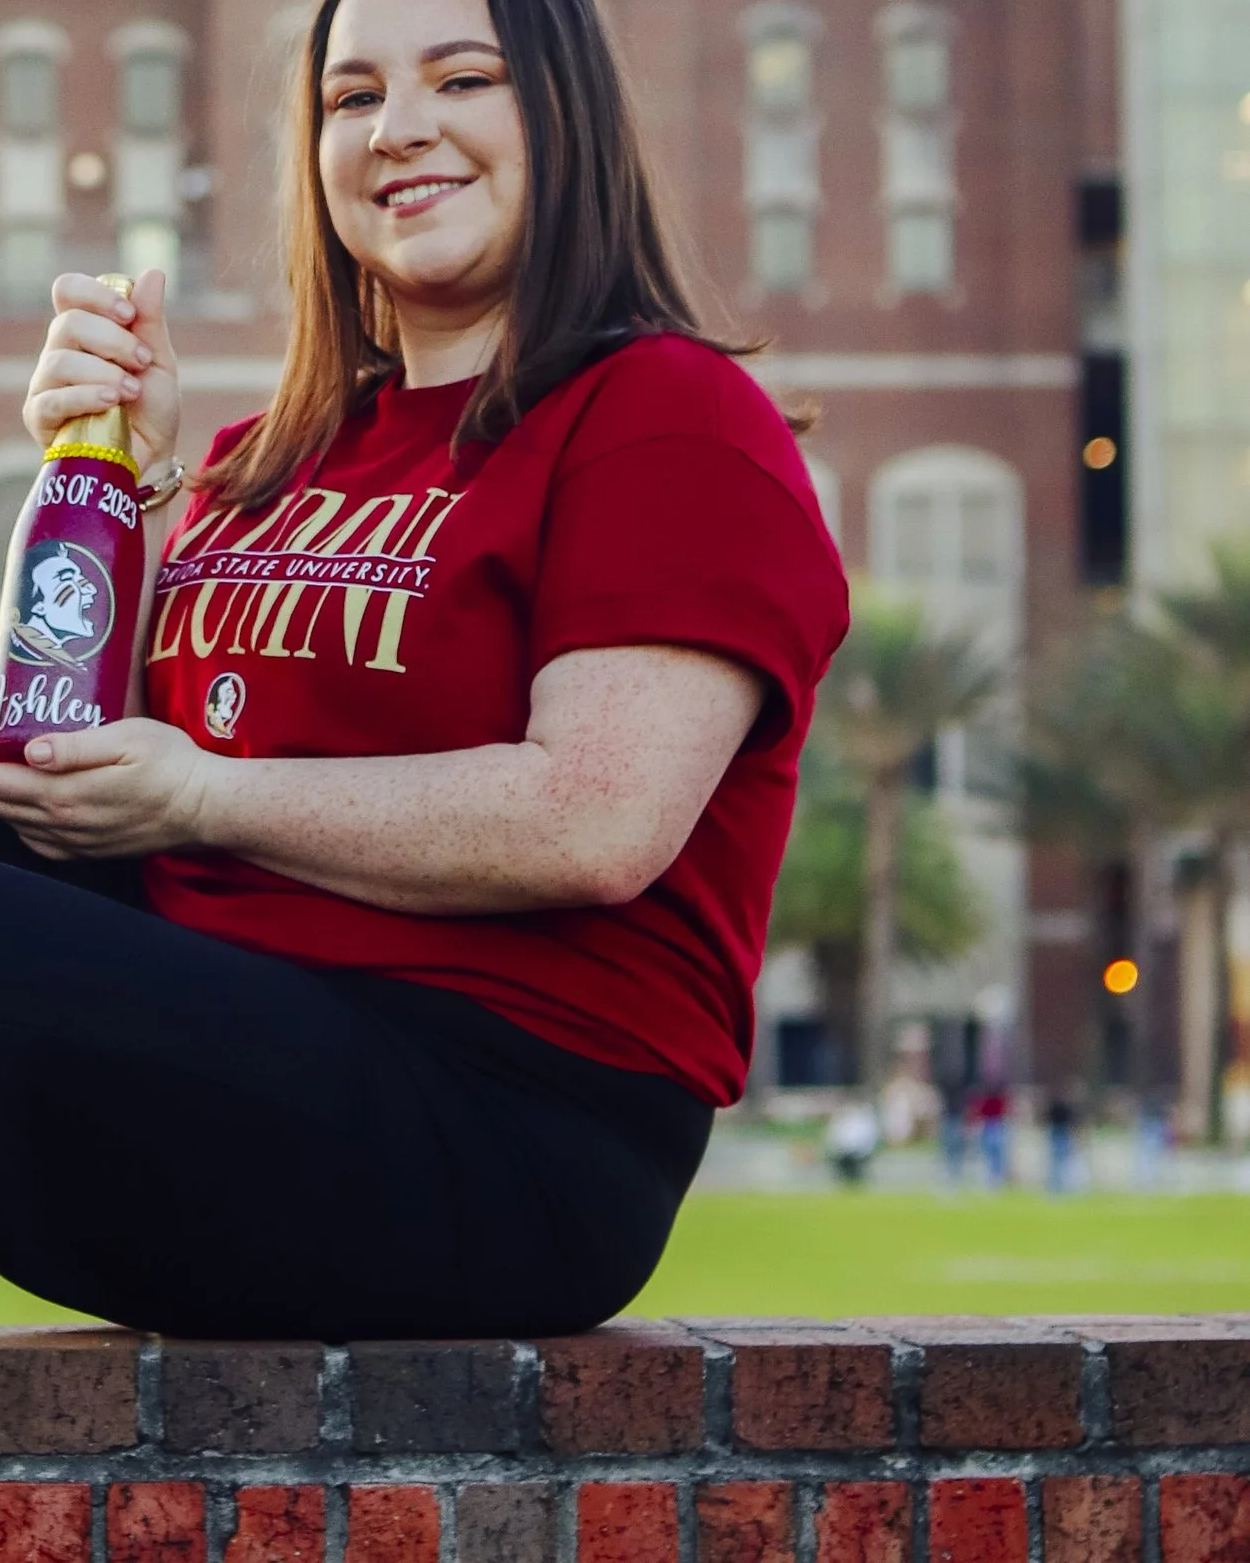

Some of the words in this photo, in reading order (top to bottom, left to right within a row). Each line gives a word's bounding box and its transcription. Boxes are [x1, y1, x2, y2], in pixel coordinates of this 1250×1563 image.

[66, 473, 99, 506] OF
[97, 482, 137, 530] 2023
[210, 556, 280, 577] STATE
